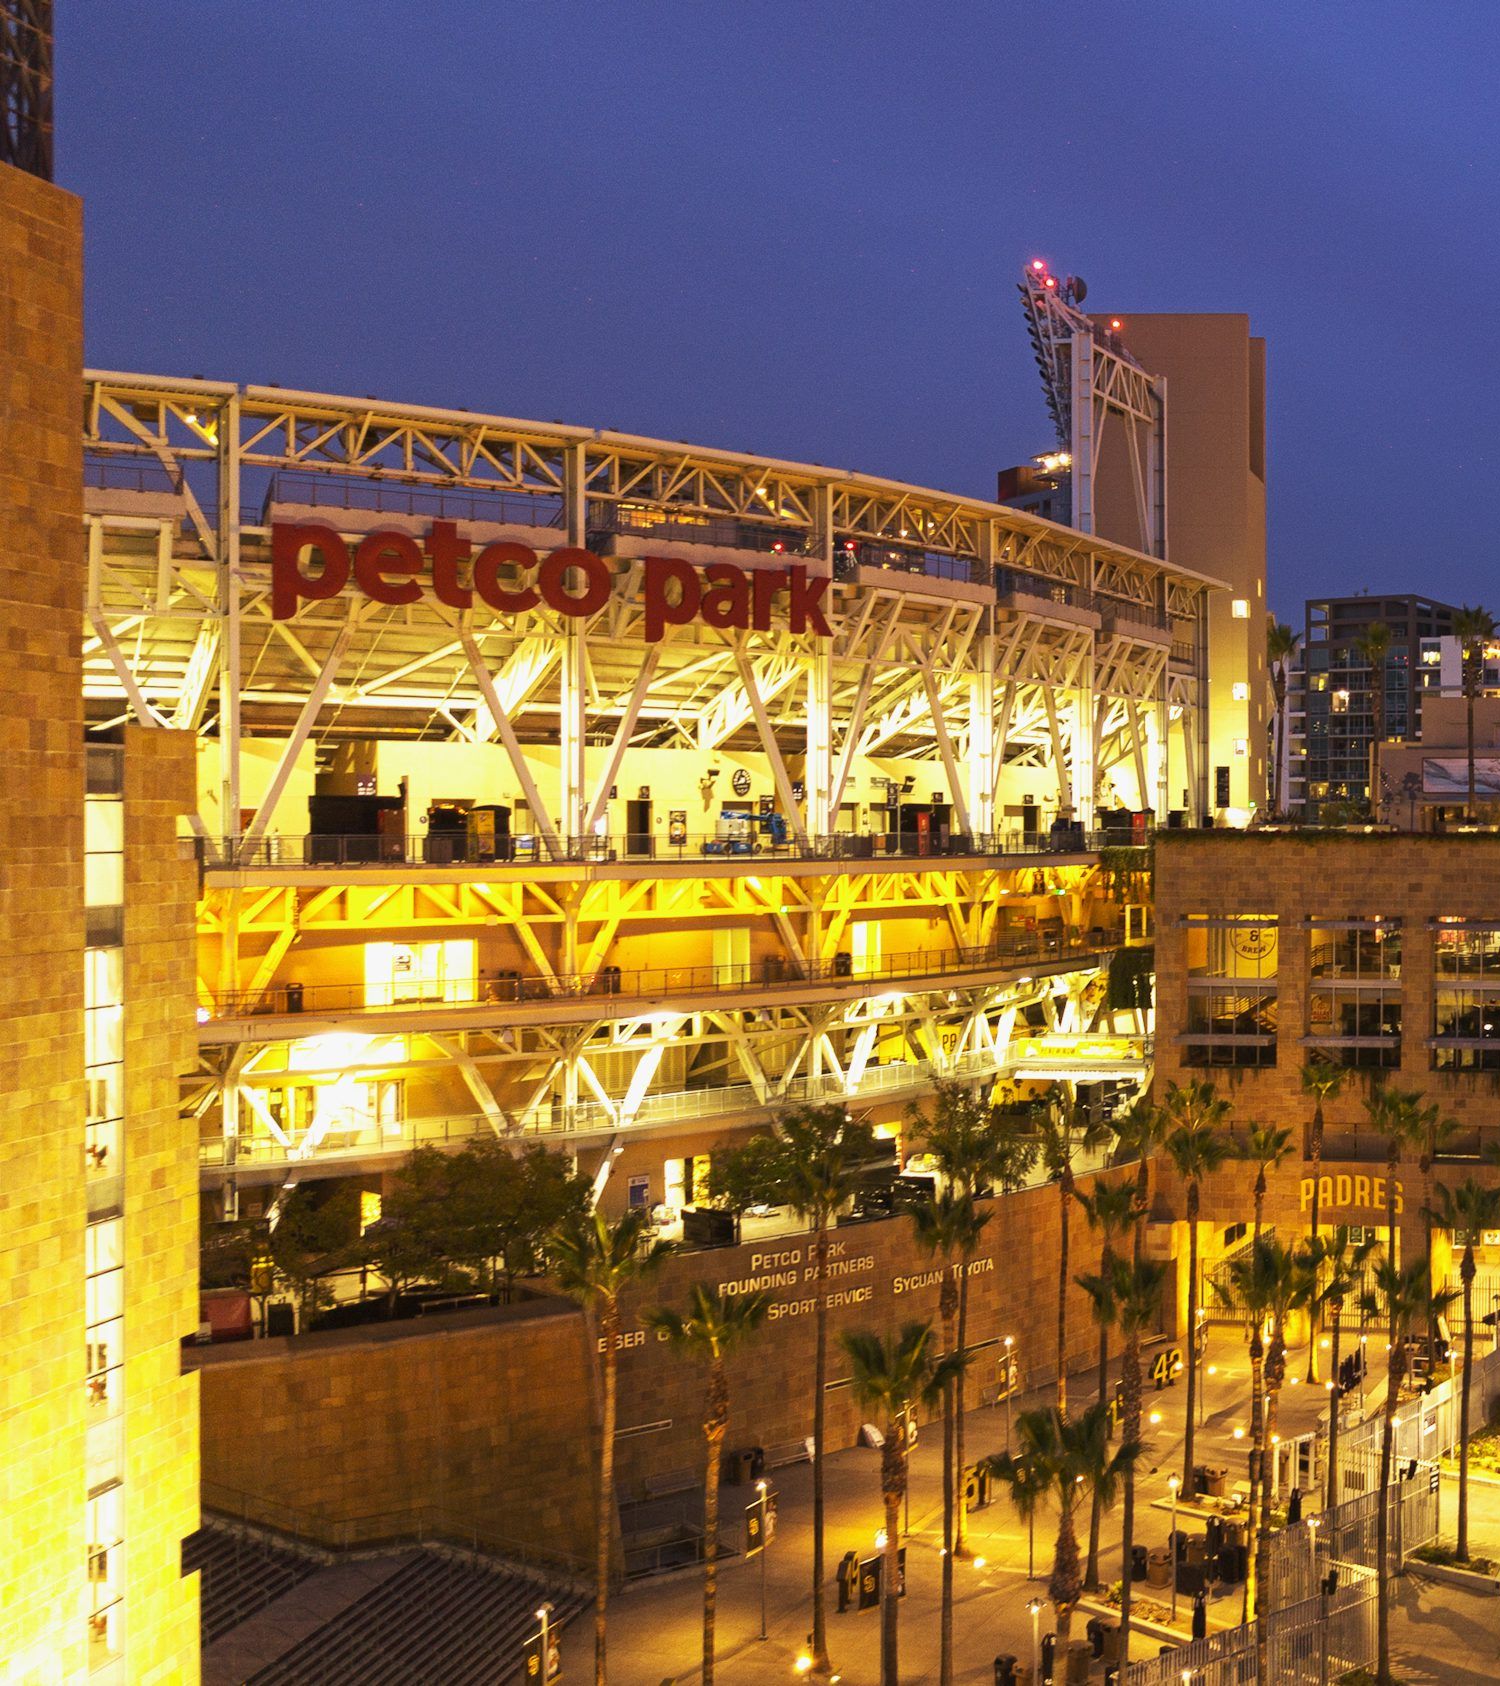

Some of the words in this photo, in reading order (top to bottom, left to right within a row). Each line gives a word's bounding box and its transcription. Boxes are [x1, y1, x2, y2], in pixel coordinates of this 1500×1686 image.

[271, 521, 611, 619] petco
[644, 556, 834, 642] park
[1241, 945, 1266, 954] BREW
[1300, 1174, 1404, 1215] PADRES
[751, 1250, 801, 1271] PETCO
[807, 1241, 847, 1262] PRK
[718, 1270, 797, 1298] FOUNDING
[768, 1286, 873, 1320] SPORTERVICE
[893, 1270, 944, 1294] SYCUAN
[1153, 1348, 1183, 1383] 42
